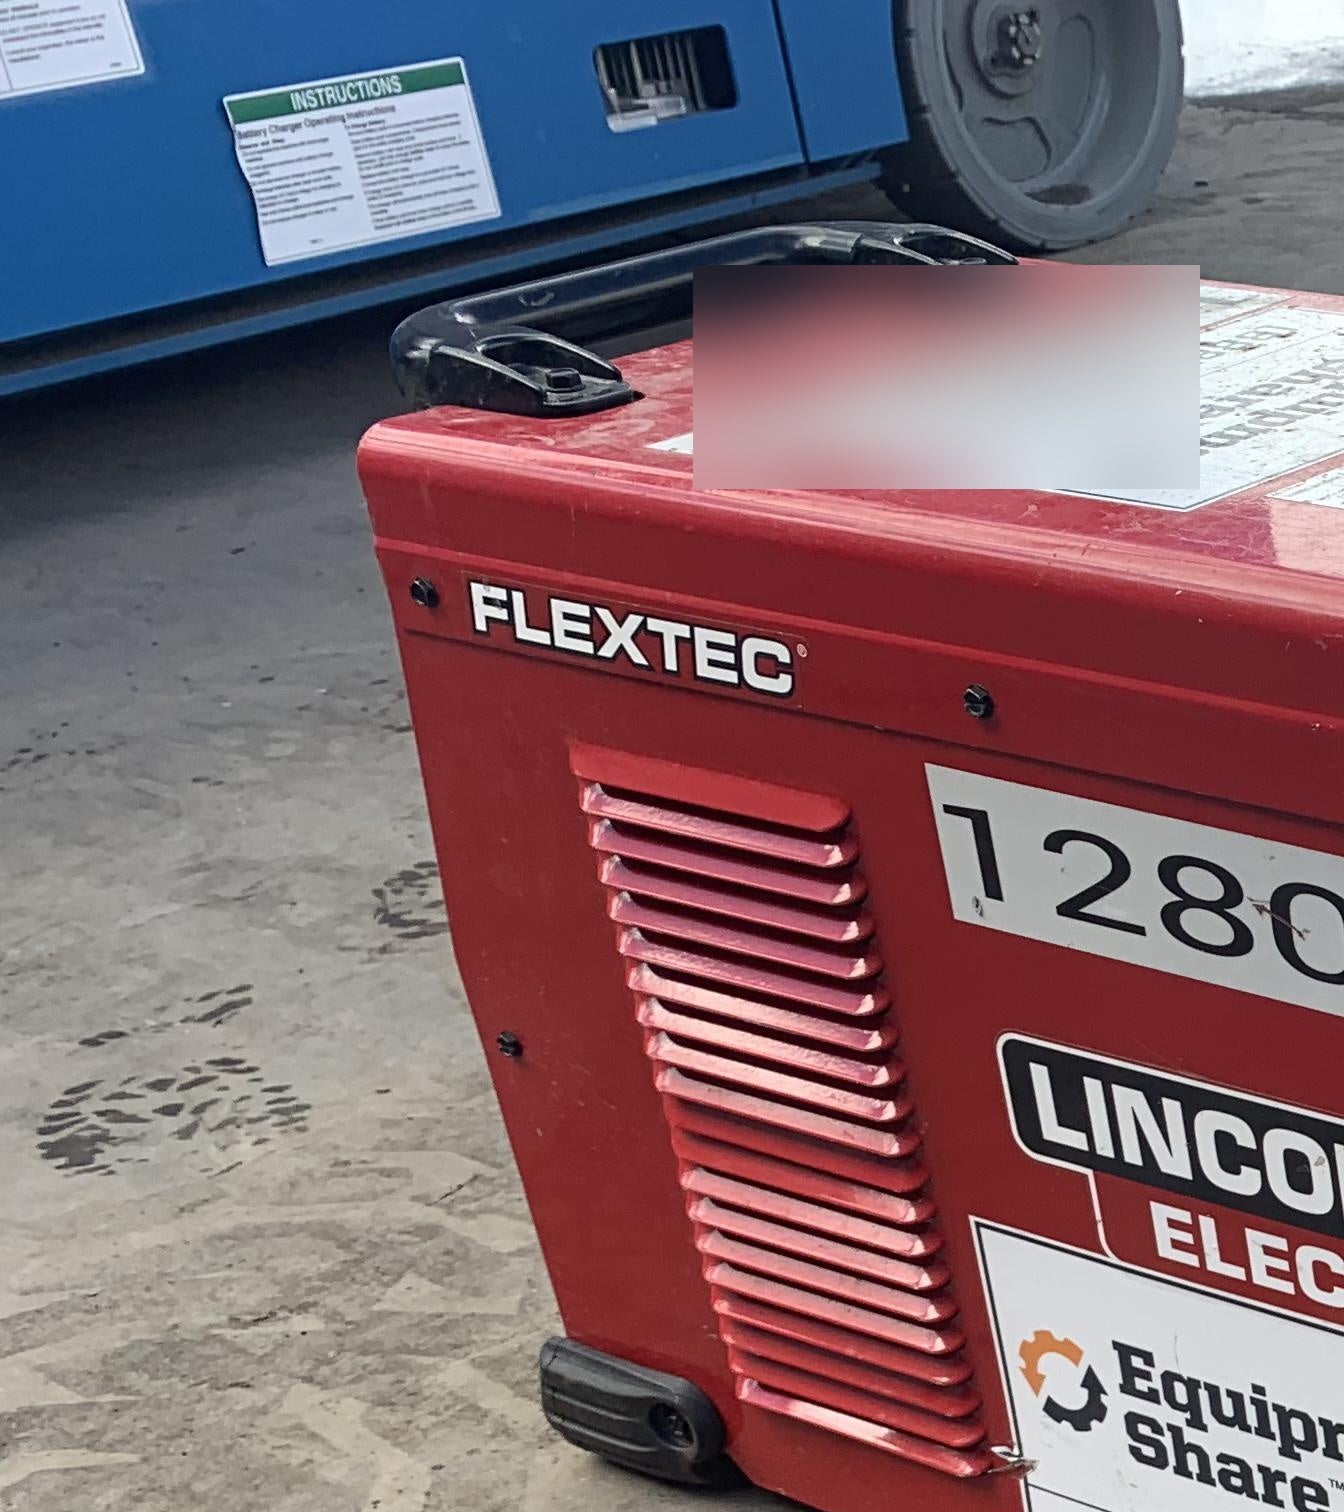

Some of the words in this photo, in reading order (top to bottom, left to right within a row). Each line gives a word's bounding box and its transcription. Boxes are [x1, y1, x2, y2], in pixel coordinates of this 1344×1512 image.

[290, 75, 403, 111] INSTRUCTIONS
[268, 122, 302, 134] Charger
[304, 114, 346, 129] Operating
[469, 581, 794, 695] FLEXTEC
